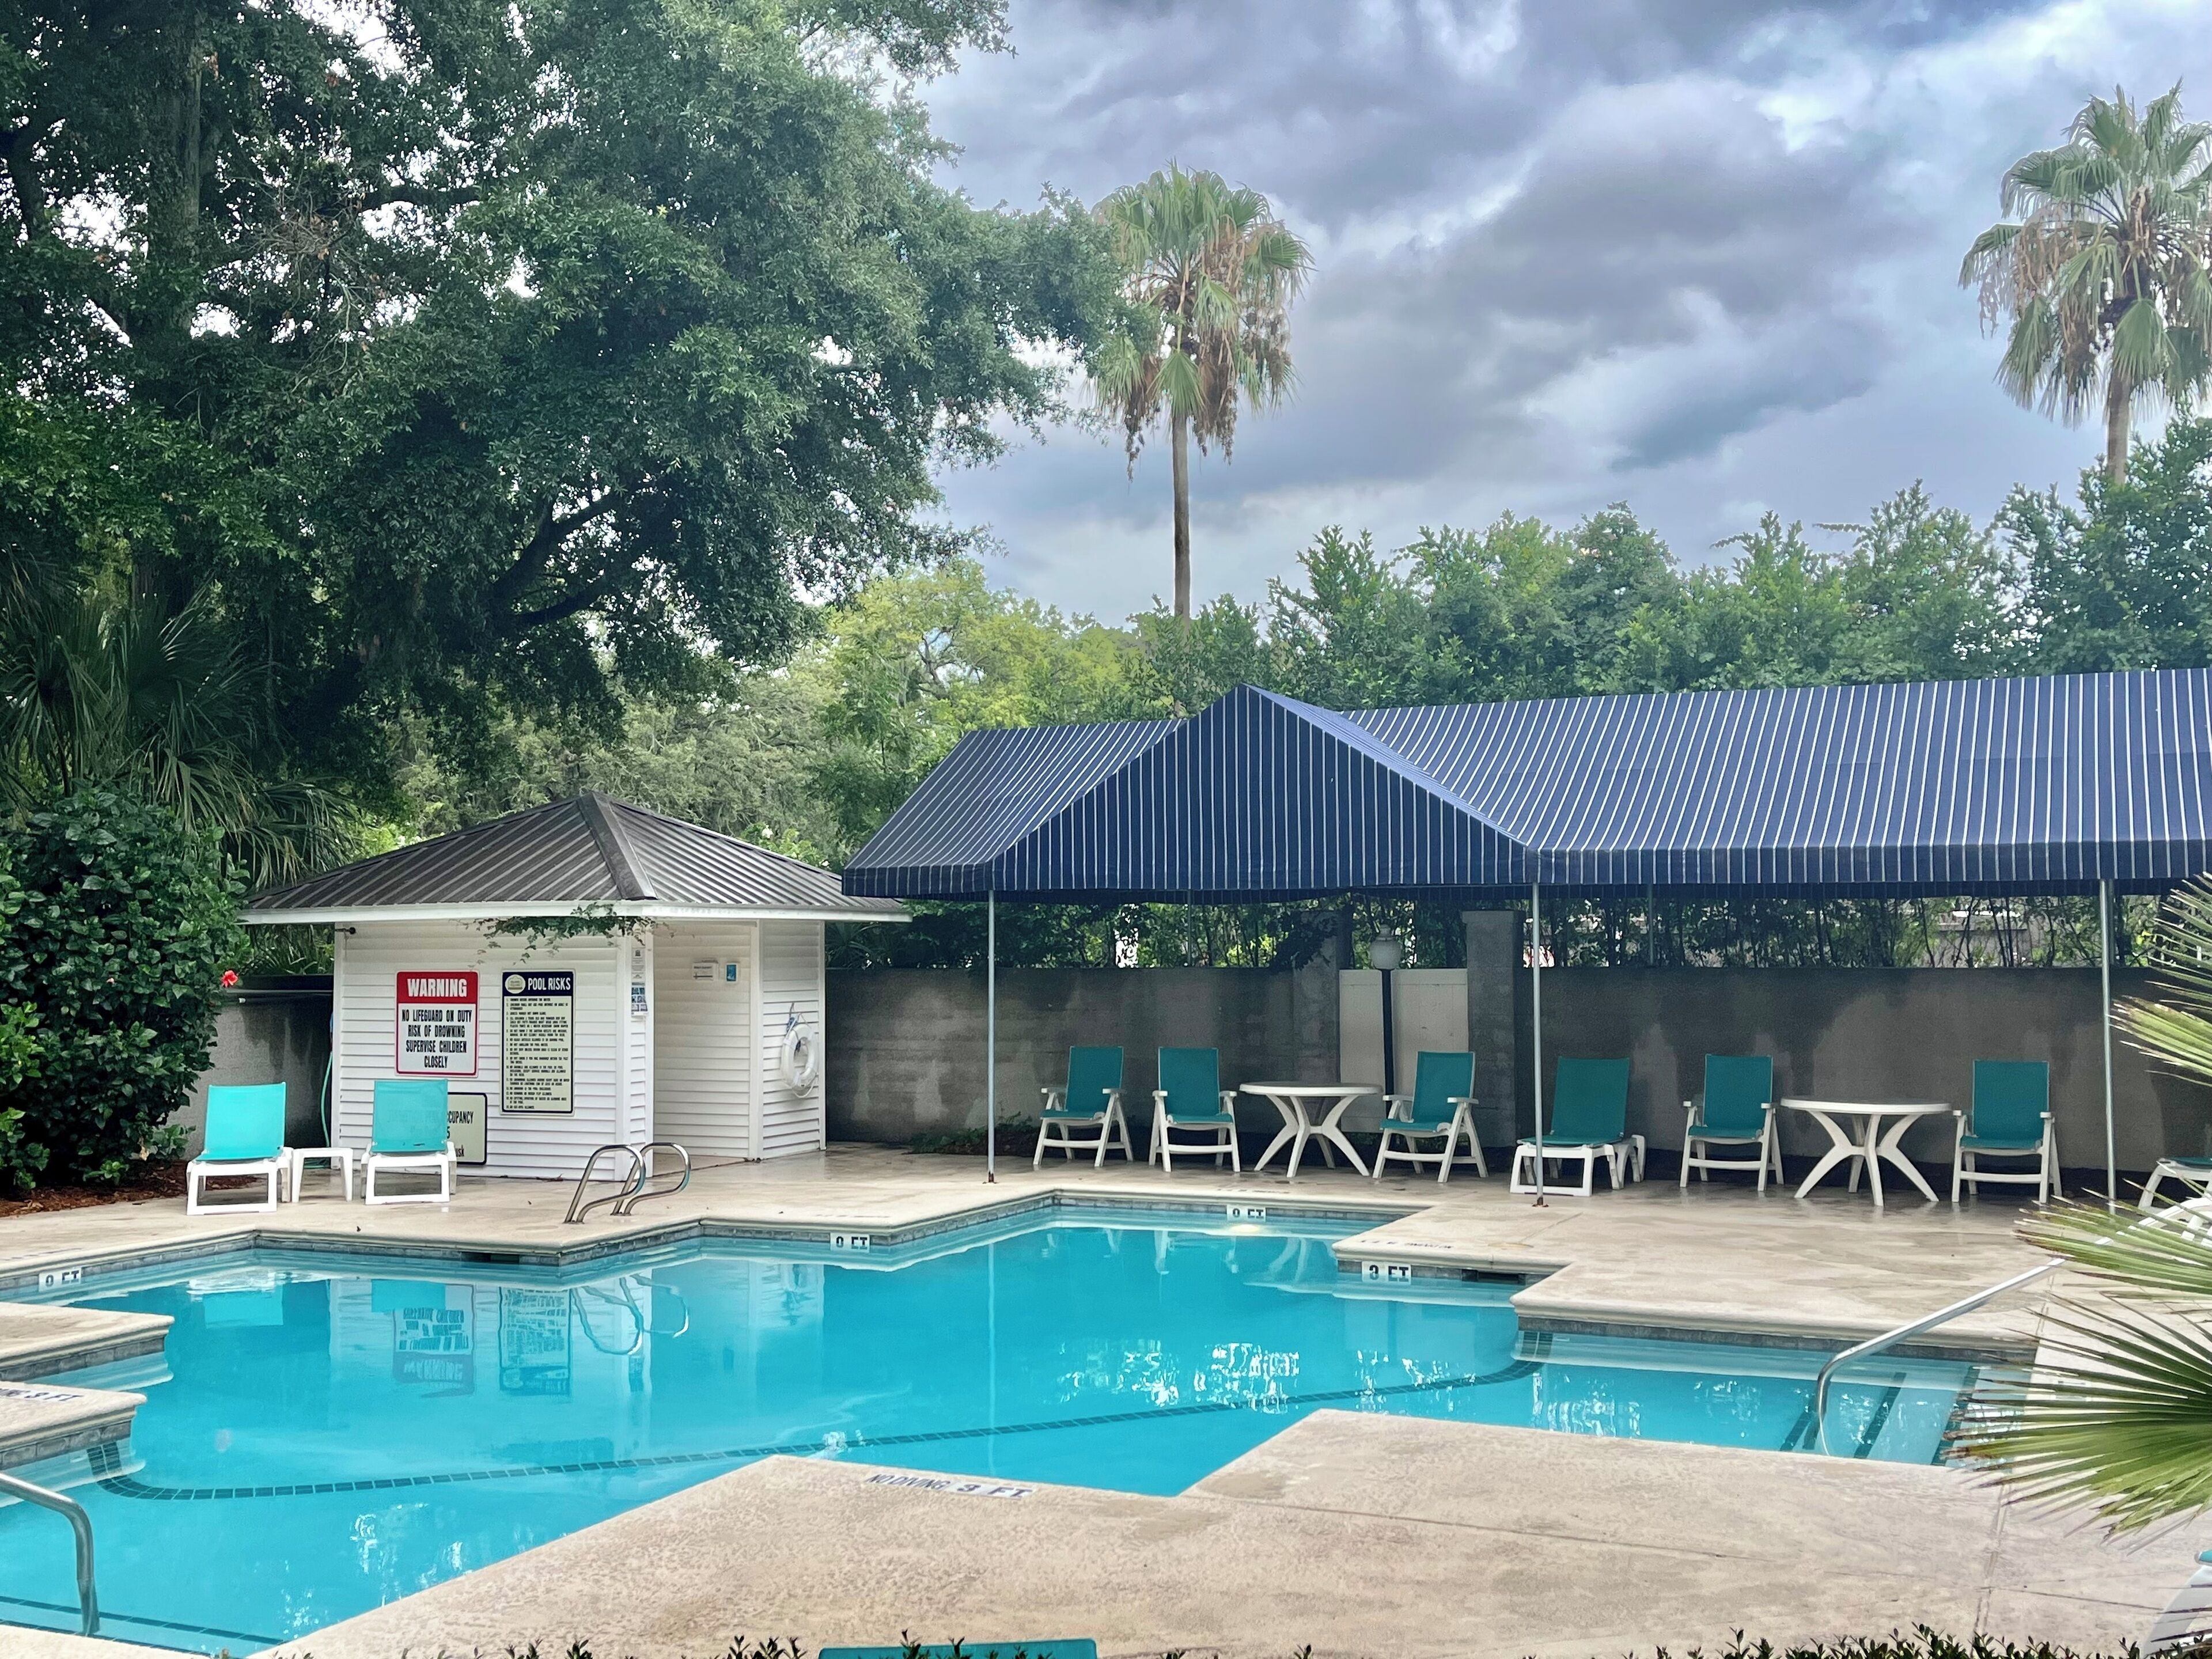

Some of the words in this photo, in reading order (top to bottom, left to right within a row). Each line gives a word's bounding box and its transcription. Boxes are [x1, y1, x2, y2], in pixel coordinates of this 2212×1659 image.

[407, 978, 468, 998] WARNING
[528, 978, 547, 990] POOL
[548, 977, 571, 990] RISKS
[402, 1009, 410, 1022] NO
[412, 1009, 443, 1022] LIFEGUARD
[446, 1010, 454, 1022] ON
[457, 1010, 472, 1022] DUTY
[408, 1025, 421, 1037] RISK
[424, 1025, 431, 1037] OF
[434, 1025, 465, 1037] DROWNING
[406, 1040, 436, 1053] SUPERVISE
[439, 1040, 467, 1053] CHILDREN
[424, 1055, 448, 1068] CLOSELY
[447, 1111, 474, 1124] CUPANCY
[987, 1486, 1033, 1498] FT
